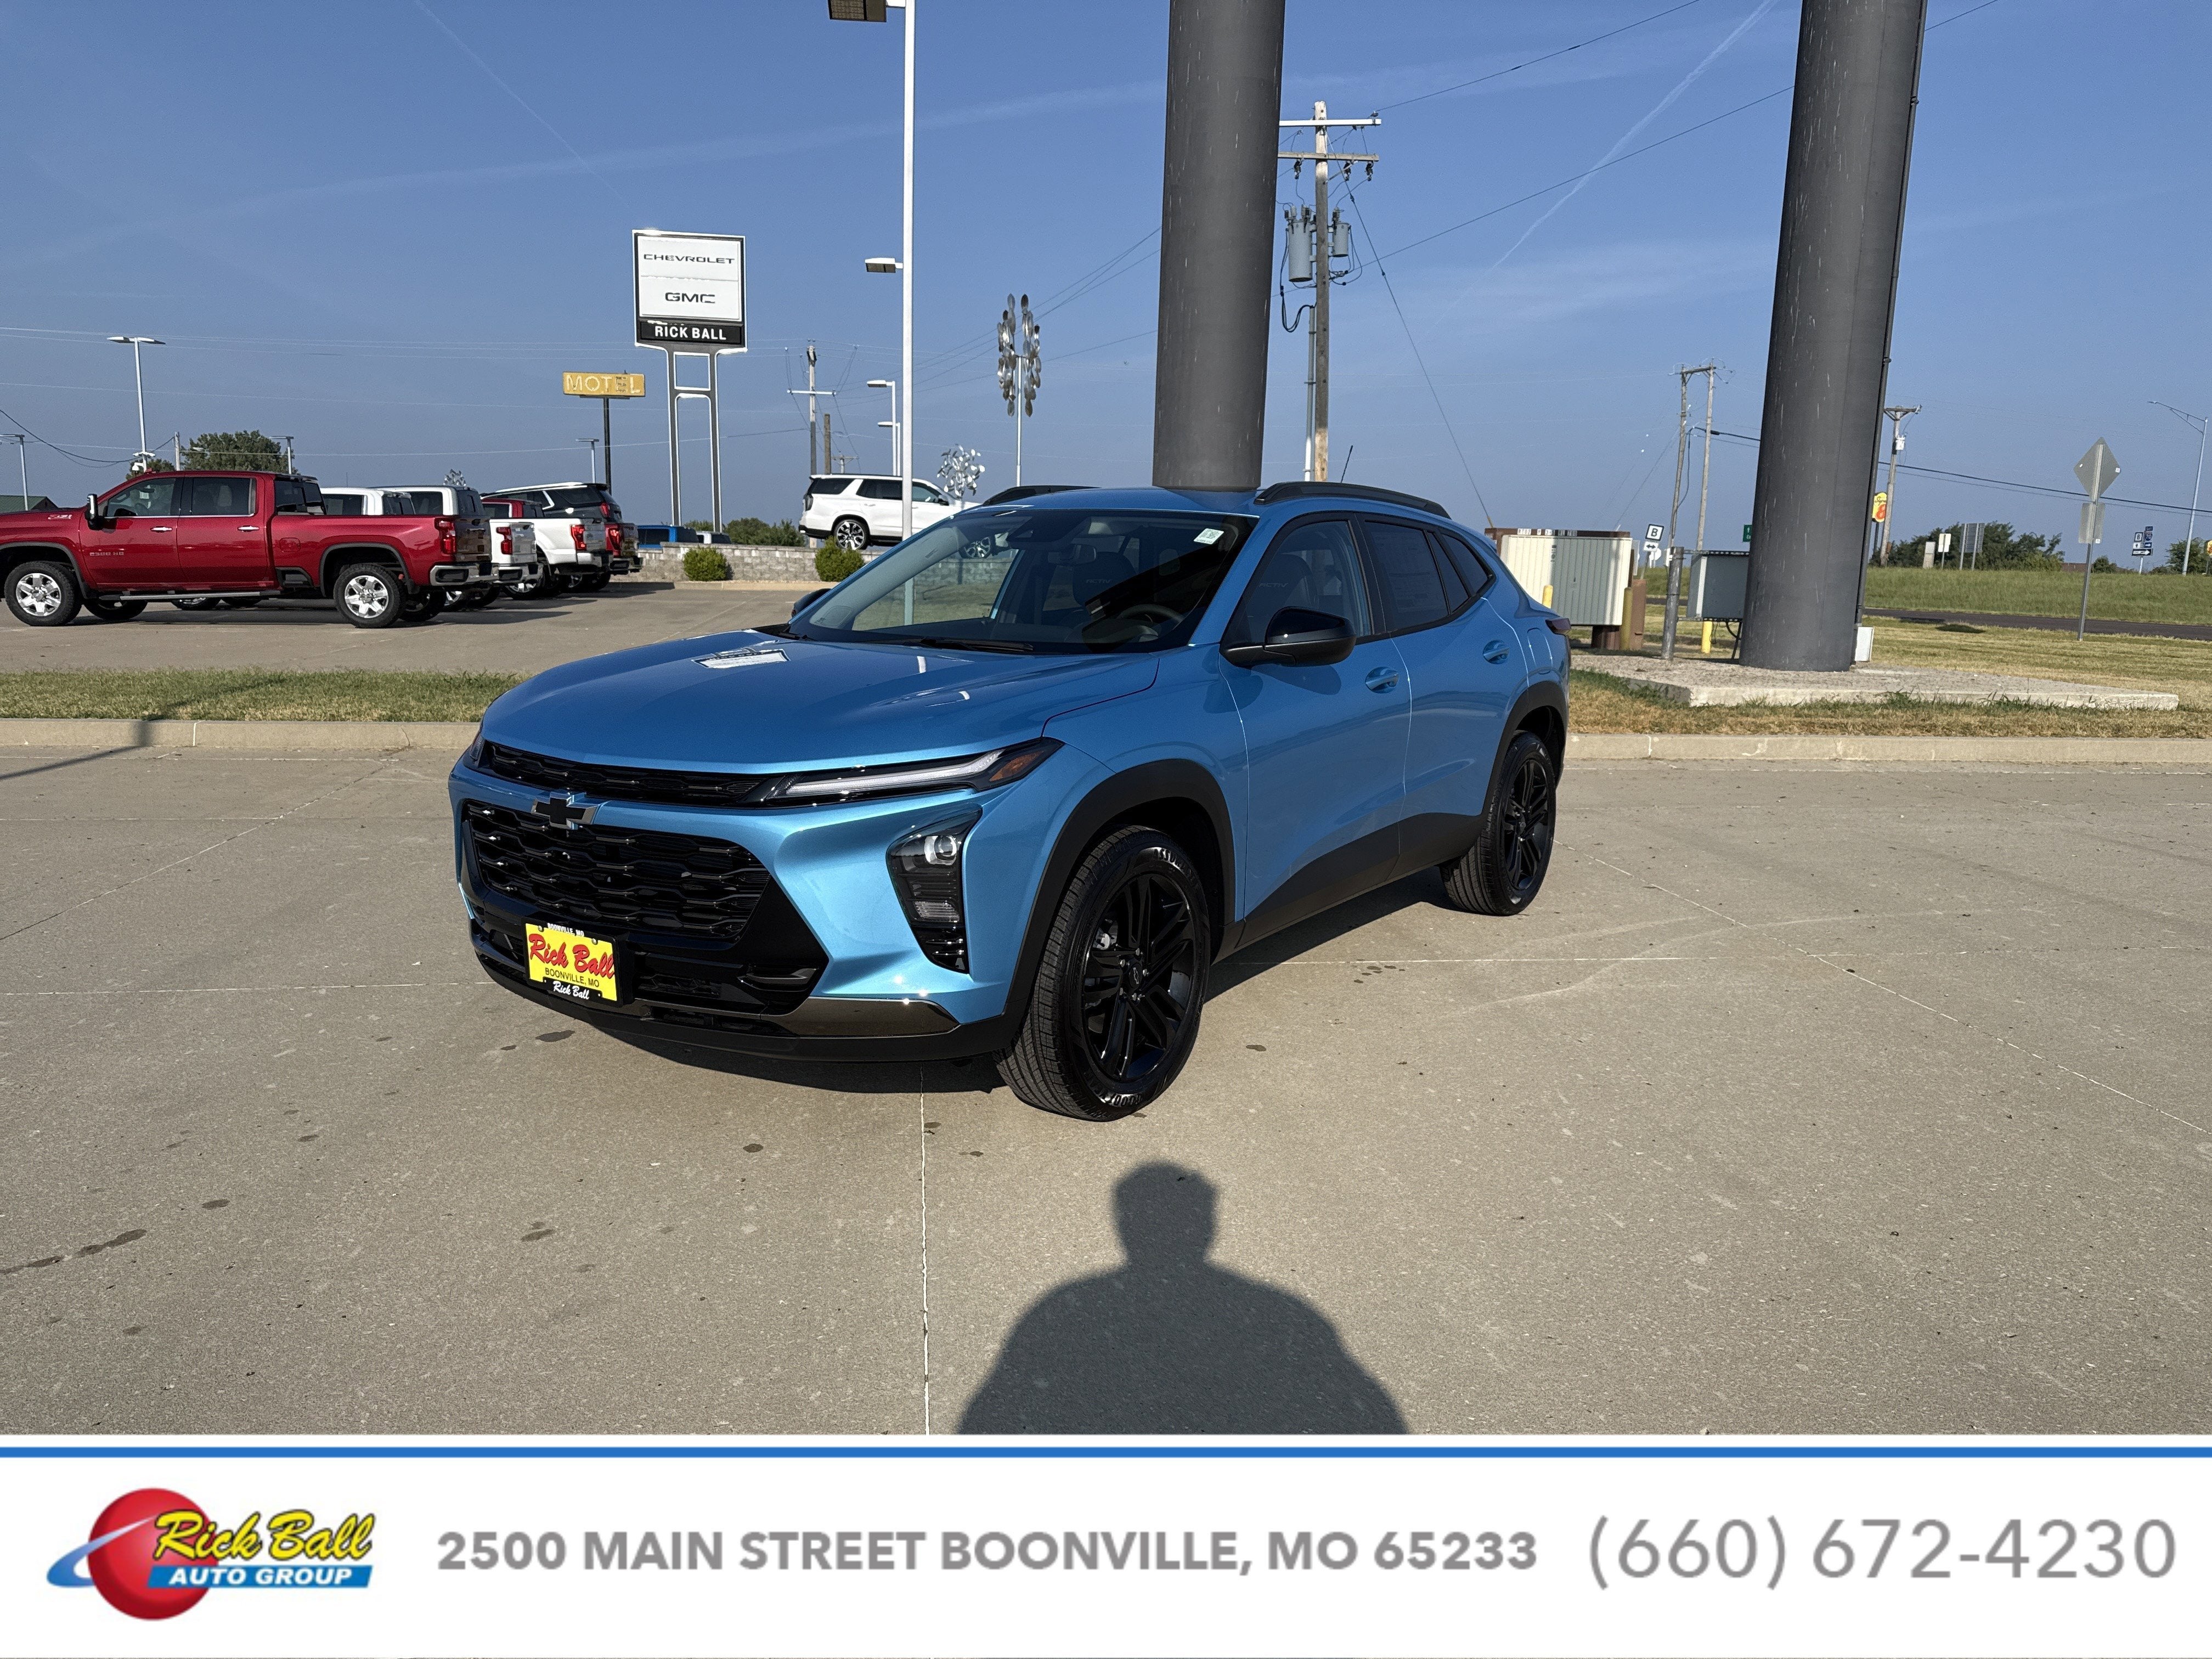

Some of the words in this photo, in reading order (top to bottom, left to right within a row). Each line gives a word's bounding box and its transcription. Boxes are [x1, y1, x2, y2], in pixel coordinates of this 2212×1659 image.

[644, 253, 735, 264] CHEVROLET
[665, 292, 715, 303] GMC
[654, 326, 688, 338] RICK
[692, 328, 727, 340] BALL
[566, 375, 641, 394] MOTEL
[1651, 528, 1658, 537] B
[528, 933, 569, 968] Rick
[572, 944, 615, 979] Ball
[545, 967, 586, 985] BOONVILLE,
[588, 978, 600, 988] MO
[552, 980, 572, 996] Rick
[572, 987, 590, 1000] Ball
